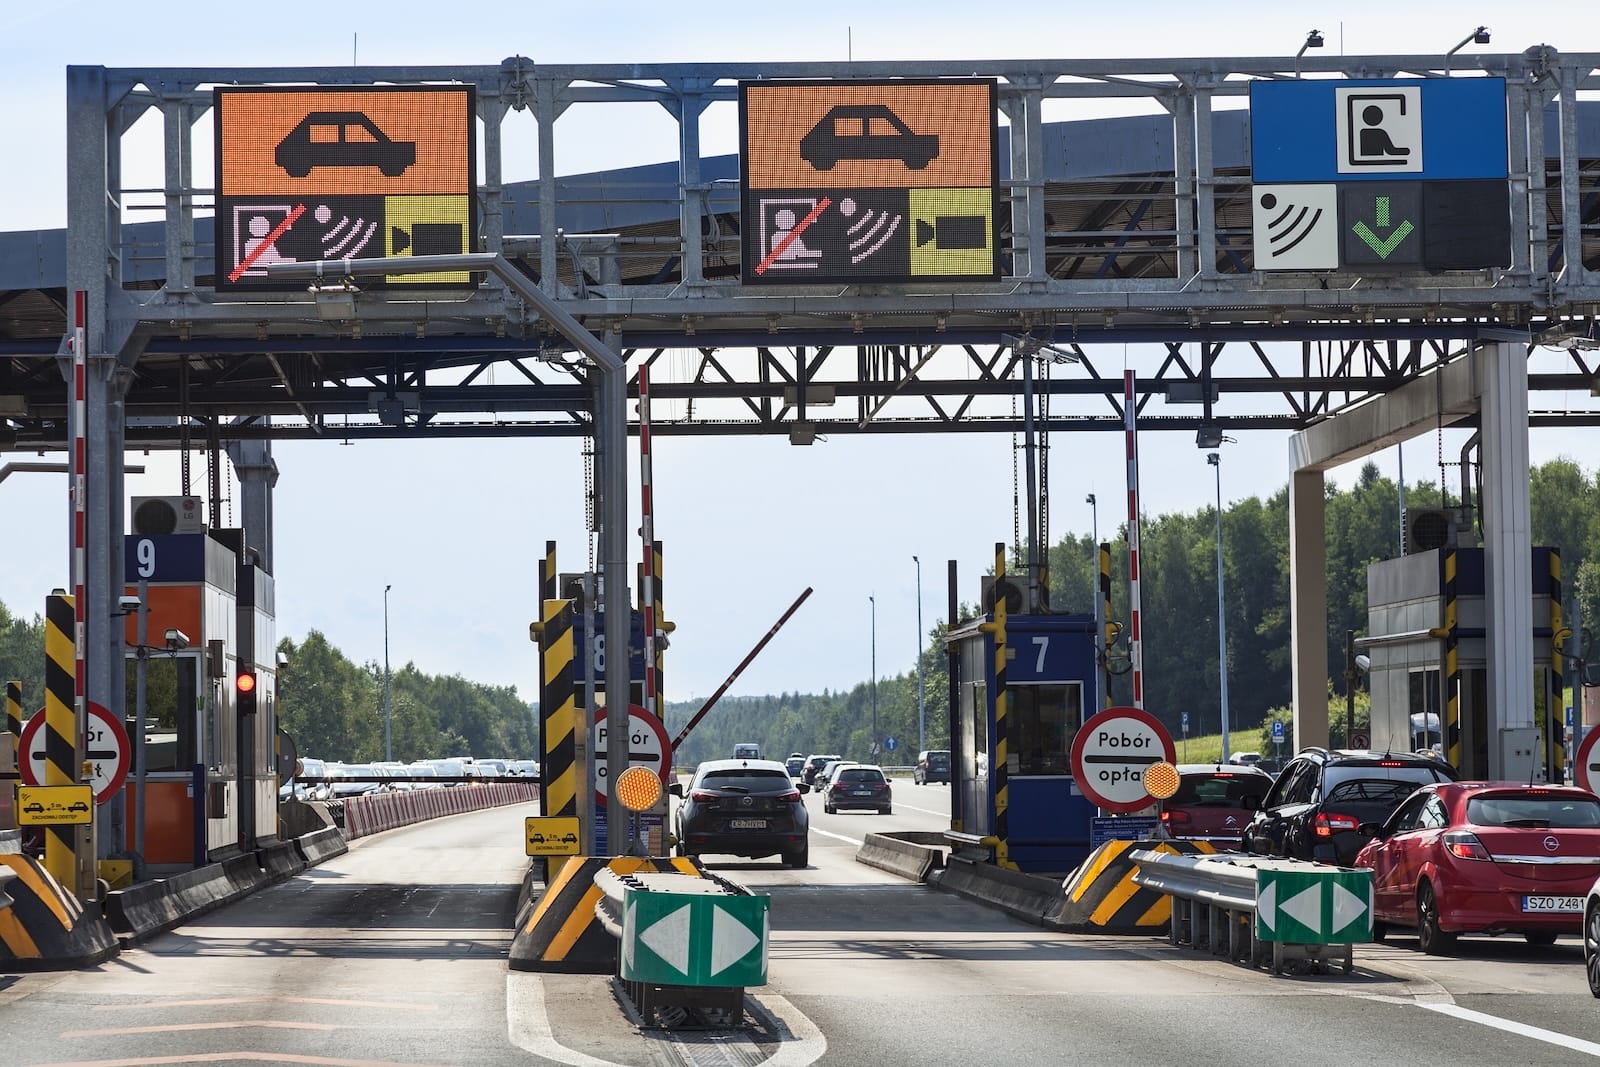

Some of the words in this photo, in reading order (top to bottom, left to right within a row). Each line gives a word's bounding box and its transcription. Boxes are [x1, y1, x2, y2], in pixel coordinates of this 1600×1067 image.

[184, 512, 194, 520] LG
[137, 538, 156, 578] 9
[594, 634, 606, 672] 8
[1032, 636, 1049, 673] 7
[1274, 722, 1282, 733] P
[1098, 732, 1151, 748] Pobór
[1098, 766, 1145, 786] opła
[1529, 898, 1554, 909] SZO
